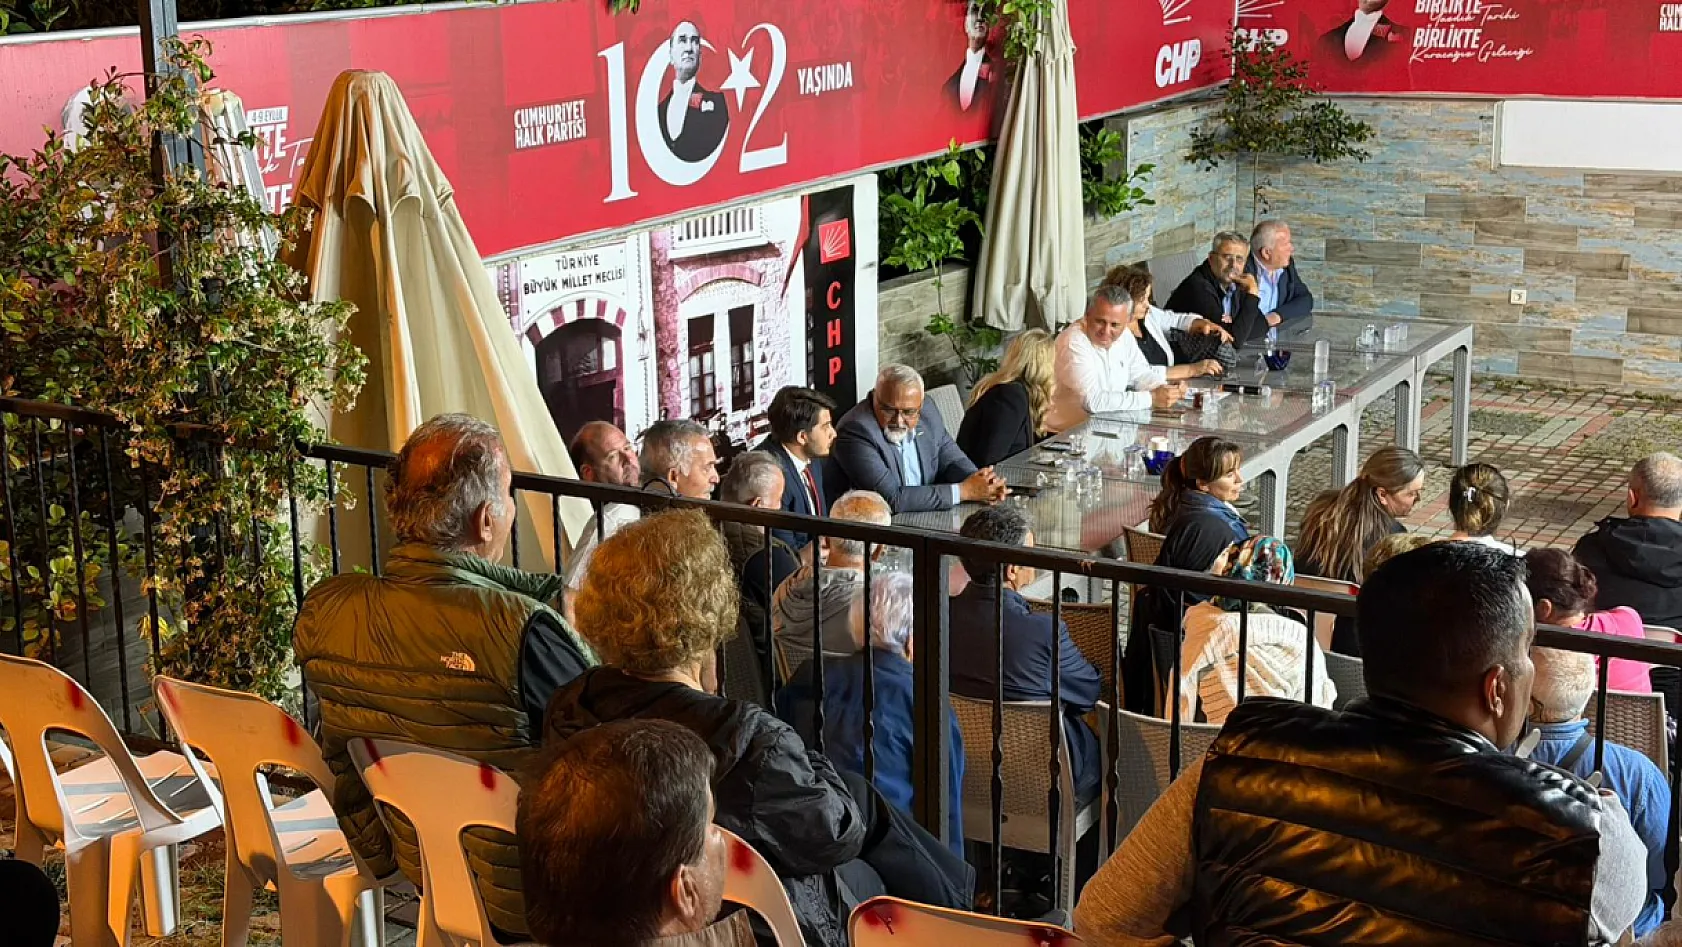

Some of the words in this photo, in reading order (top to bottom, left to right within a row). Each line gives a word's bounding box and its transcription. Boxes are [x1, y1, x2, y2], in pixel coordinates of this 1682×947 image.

[1413, 24, 1482, 49] BİRLİKTE
[1660, 17, 1682, 32] HAL
[1155, 39, 1201, 88] CHP
[797, 61, 853, 97] YAŞINDA
[514, 99, 585, 128] CUMHURİYET
[598, 22, 788, 203] 102
[515, 125, 544, 149] HALK
[546, 118, 587, 144] PARTİSİ
[555, 253, 600, 271] TÜRKİYE
[523, 276, 558, 295] BÜYÜK
[561, 273, 592, 290] MİLLET
